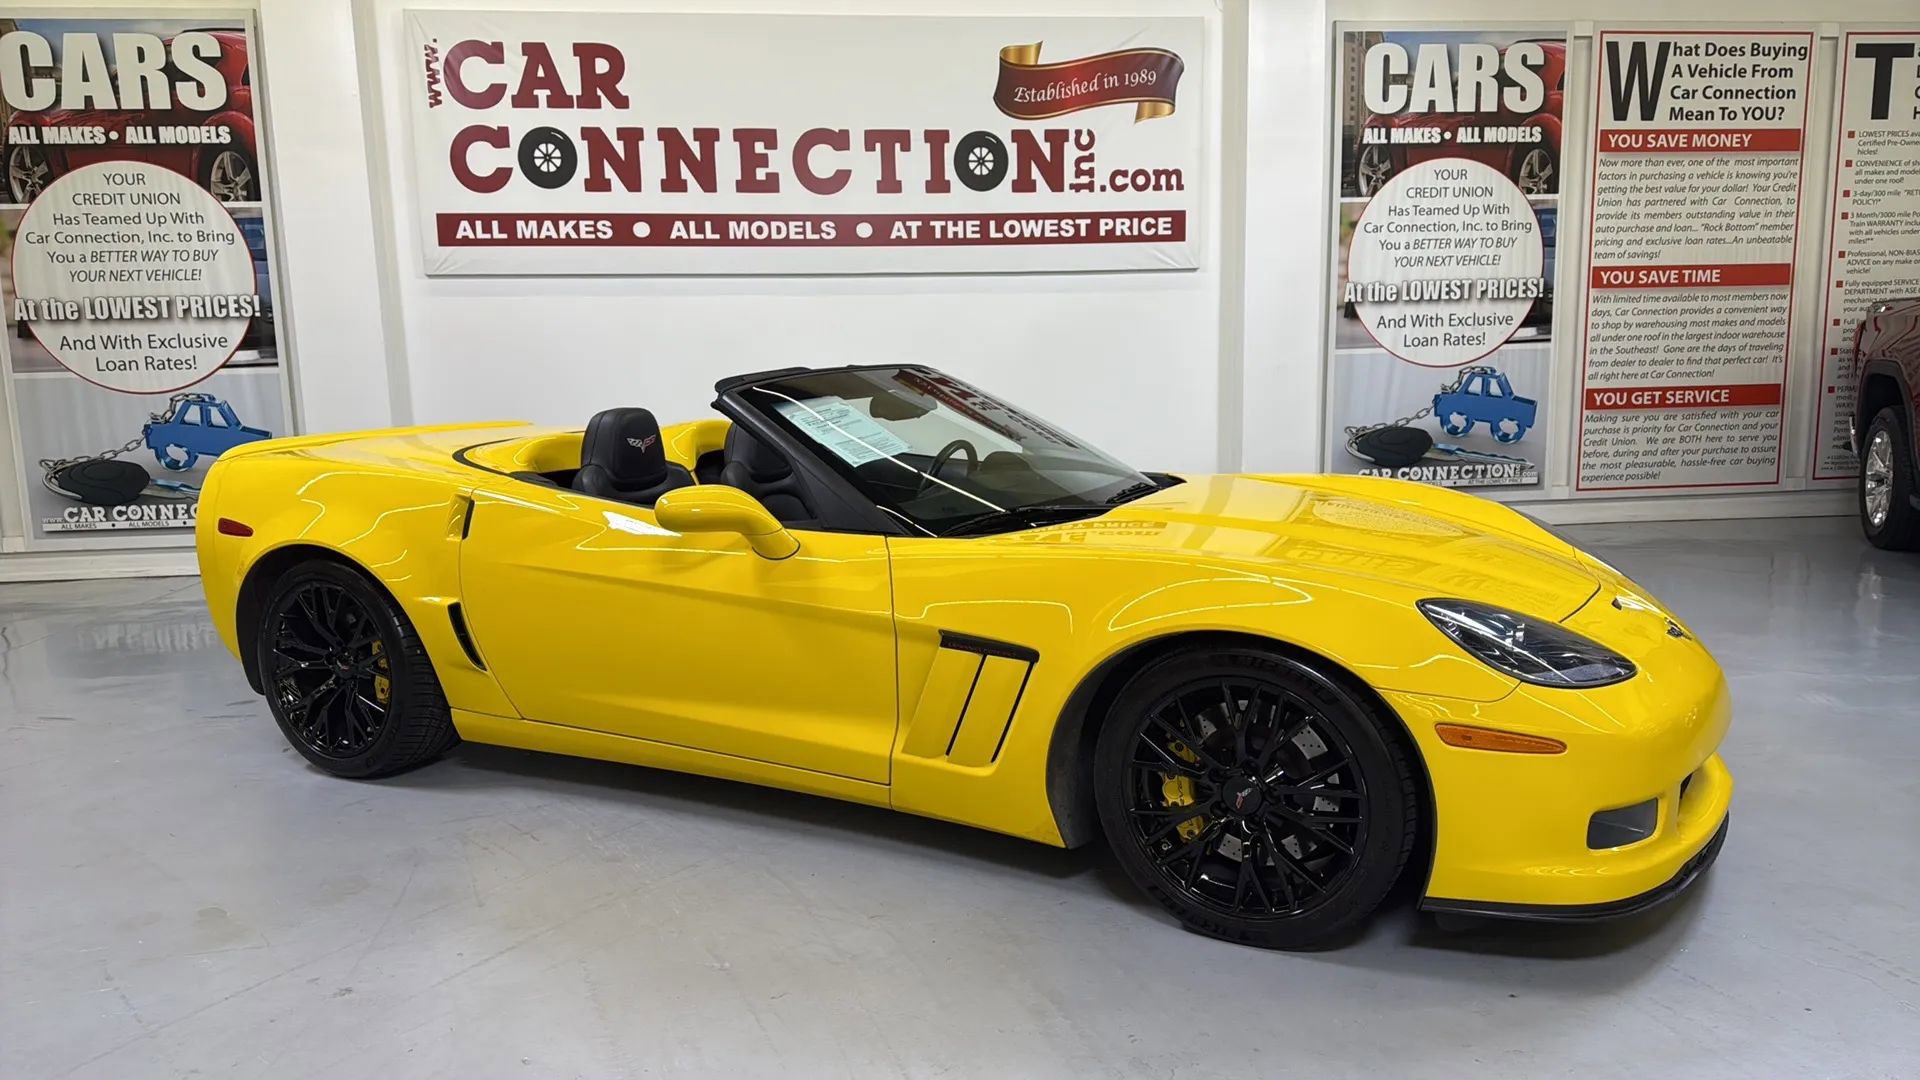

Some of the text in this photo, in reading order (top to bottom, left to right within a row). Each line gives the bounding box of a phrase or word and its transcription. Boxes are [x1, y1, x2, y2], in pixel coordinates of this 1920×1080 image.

[1704, 43, 1746, 57] Does
[1750, 42, 1808, 60] Buying
[0, 30, 227, 111] CARS
[424, 38, 443, 109] www.
[443, 39, 630, 110] CAR
[1364, 42, 1545, 114] CARS
[1672, 64, 1793, 78] A Vehicle From
[1013, 68, 1157, 104] Established in 1989
[1670, 85, 1796, 99] Car Connection
[1669, 106, 1785, 121] Mean To YOU?
[9, 126, 231, 144] ALL MAKES ALL MODELS
[1363, 127, 1542, 144] ALL MAKES ALL MODELS
[1608, 134, 1752, 148] YOU SAVE MONEY
[449, 124, 1070, 195] CONNECTION
[1599, 159, 1619, 167] Now
[1645, 158, 1664, 167] than
[1666, 159, 1686, 168] ever,
[1706, 158, 1714, 166] of
[1717, 158, 1730, 166] the
[1757, 158, 1799, 168] important
[103, 173, 146, 185] YOUR
[1100, 168, 1185, 193] .com
[1434, 169, 1467, 180] YOUR
[72, 192, 180, 206] CREDIT UNION
[1406, 187, 1493, 198] CREDIT UNION
[1388, 204, 1510, 217] Has Teamed Up With
[53, 212, 204, 227] Has Teamed Up With
[1364, 220, 1532, 234] Car Connection, Inc. to Bring
[456, 217, 1172, 240] ALL MAKES ALL MODELS AT THE LOWEST PRICE
[25, 230, 235, 245] Car Connection, Inc. to Bring
[1379, 240, 1402, 251] You
[1413, 239, 1451, 250] BETTER
[1454, 238, 1476, 249] WAY
[1480, 238, 1494, 248] TO
[1496, 238, 1518, 248] BUY
[47, 250, 218, 263] You a BETTER WAY TO BUY
[1394, 255, 1501, 267] YOUR NEXT VEHICLE!
[1594, 250, 1661, 260] team of savings!
[70, 269, 202, 282] YOUR NEXT VEHICLE!
[1600, 270, 1721, 285] YOU SAVE TIME
[1344, 278, 1544, 303] At the LOWEST PRICES!
[15, 295, 261, 321] At the LOWEST PRICES!
[1377, 313, 1514, 328] And With Exclusive
[60, 333, 228, 351] And With Exclusive
[1404, 332, 1486, 347] Loan Rates!
[96, 355, 197, 371] Loan Rates!
[1588, 369, 1714, 381] all right here at Car Connection!
[1594, 389, 1729, 405] YOU GET SERVICE
[1583, 438, 1608, 447] Credit
[1611, 437, 1637, 446] Union.
[1646, 436, 1659, 445] We
[1679, 436, 1702, 444] BOTH
[1398, 464, 1516, 481] CONNECTION
[1581, 472, 1661, 482] experience possible!
[63, 506, 107, 523] CAR
